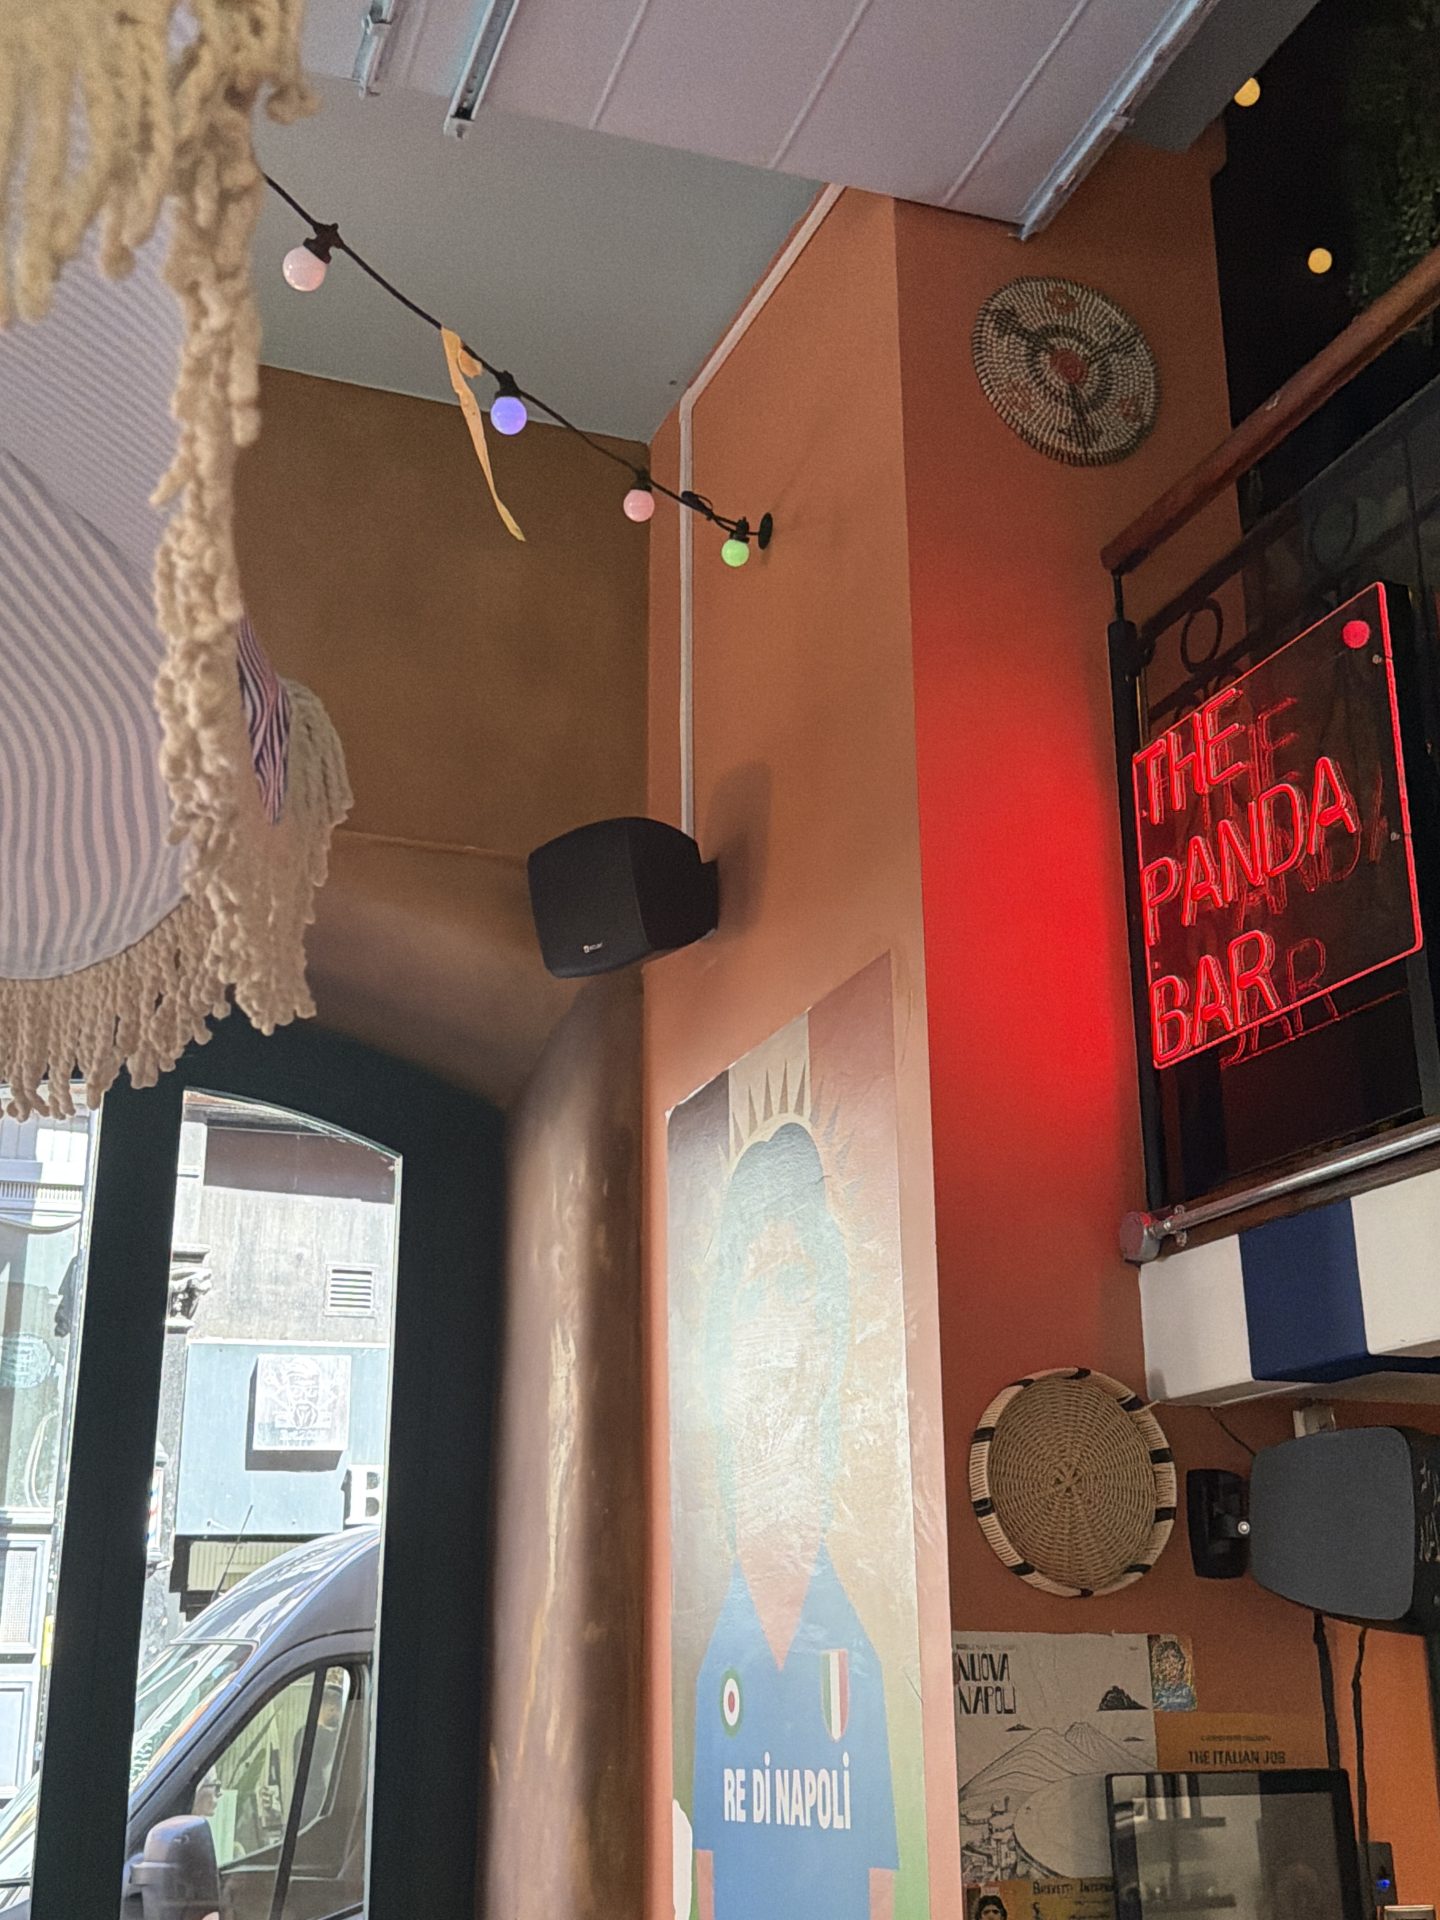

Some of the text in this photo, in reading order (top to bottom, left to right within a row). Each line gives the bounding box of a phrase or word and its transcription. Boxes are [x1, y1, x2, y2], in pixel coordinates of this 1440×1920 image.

[1134, 688, 1244, 825] THE
[1141, 756, 1357, 945] PANDA
[1150, 930, 1277, 1062] BAR
[957, 1653, 1010, 1681] NUOVA
[958, 1686, 1016, 1714] NAPOLI
[1188, 1750, 1286, 1765] THE ITALIAN JOB
[723, 1768, 746, 1822] RE
